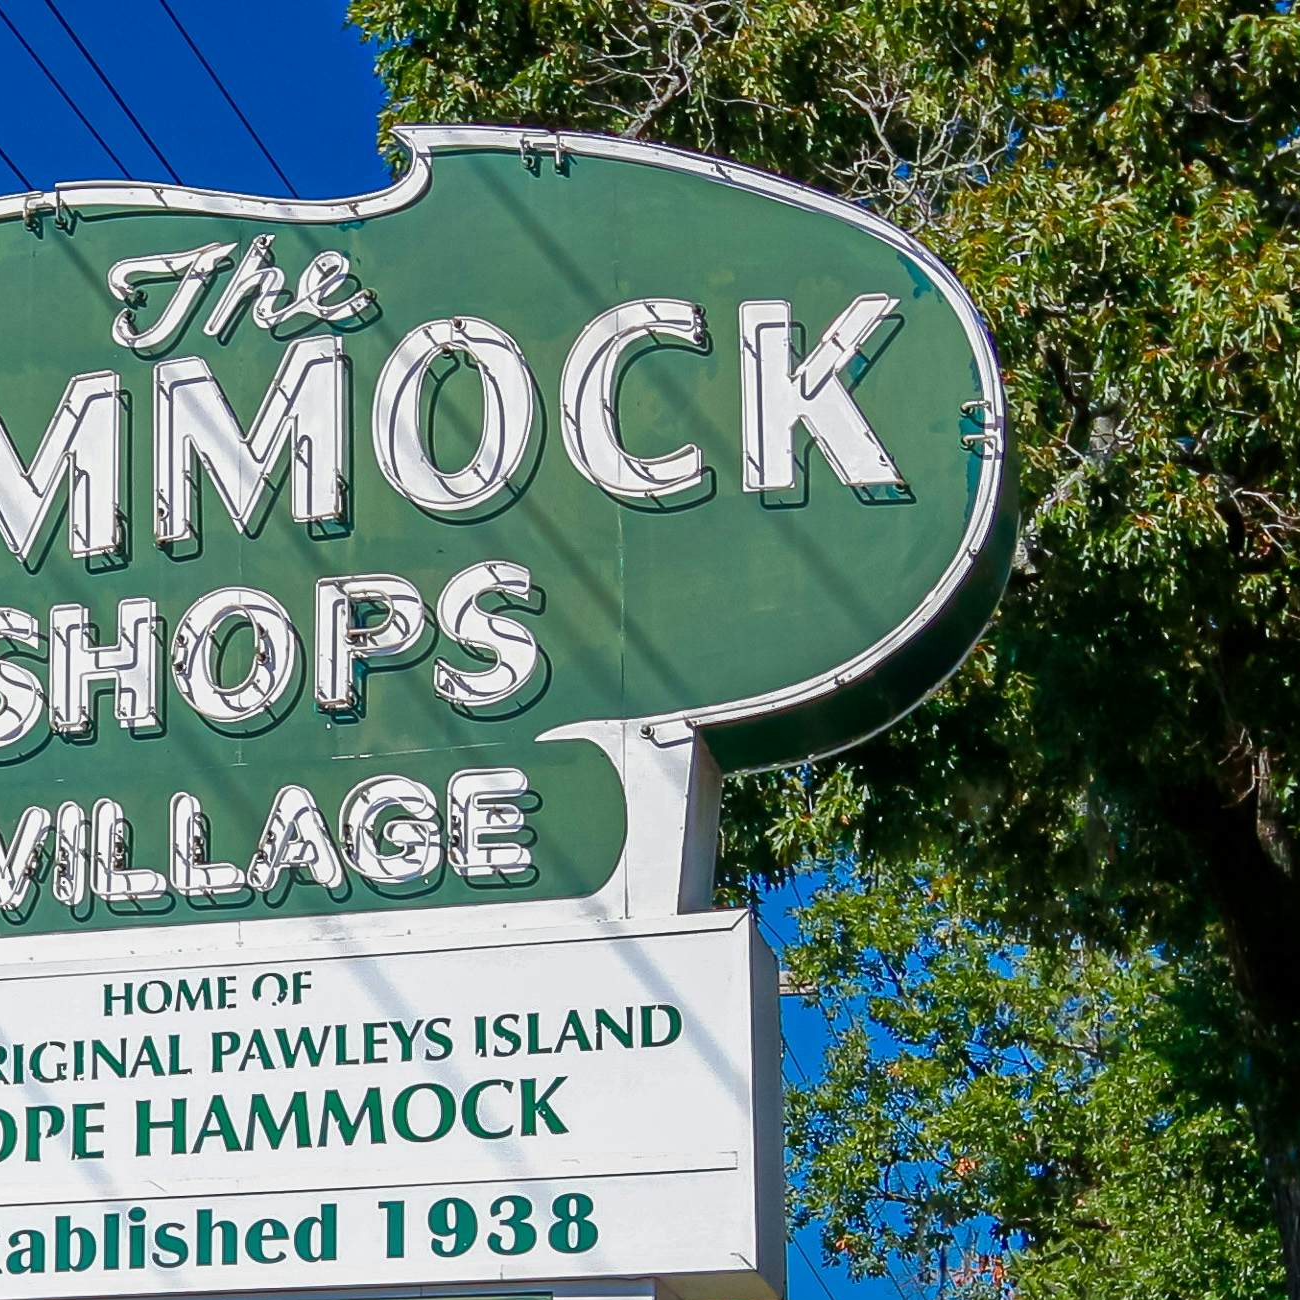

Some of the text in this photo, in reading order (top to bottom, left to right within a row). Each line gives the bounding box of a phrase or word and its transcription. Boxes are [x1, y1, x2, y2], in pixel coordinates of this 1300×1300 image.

[108, 234, 375, 352] The
[102, 970, 313, 1017] HOME OF
[212, 1017, 454, 1073] PAWLEYS
[475, 1003, 682, 1057] ISLAND
[136, 1076, 569, 1158] HAMMOCK
[378, 1193, 600, 1261] 1938
